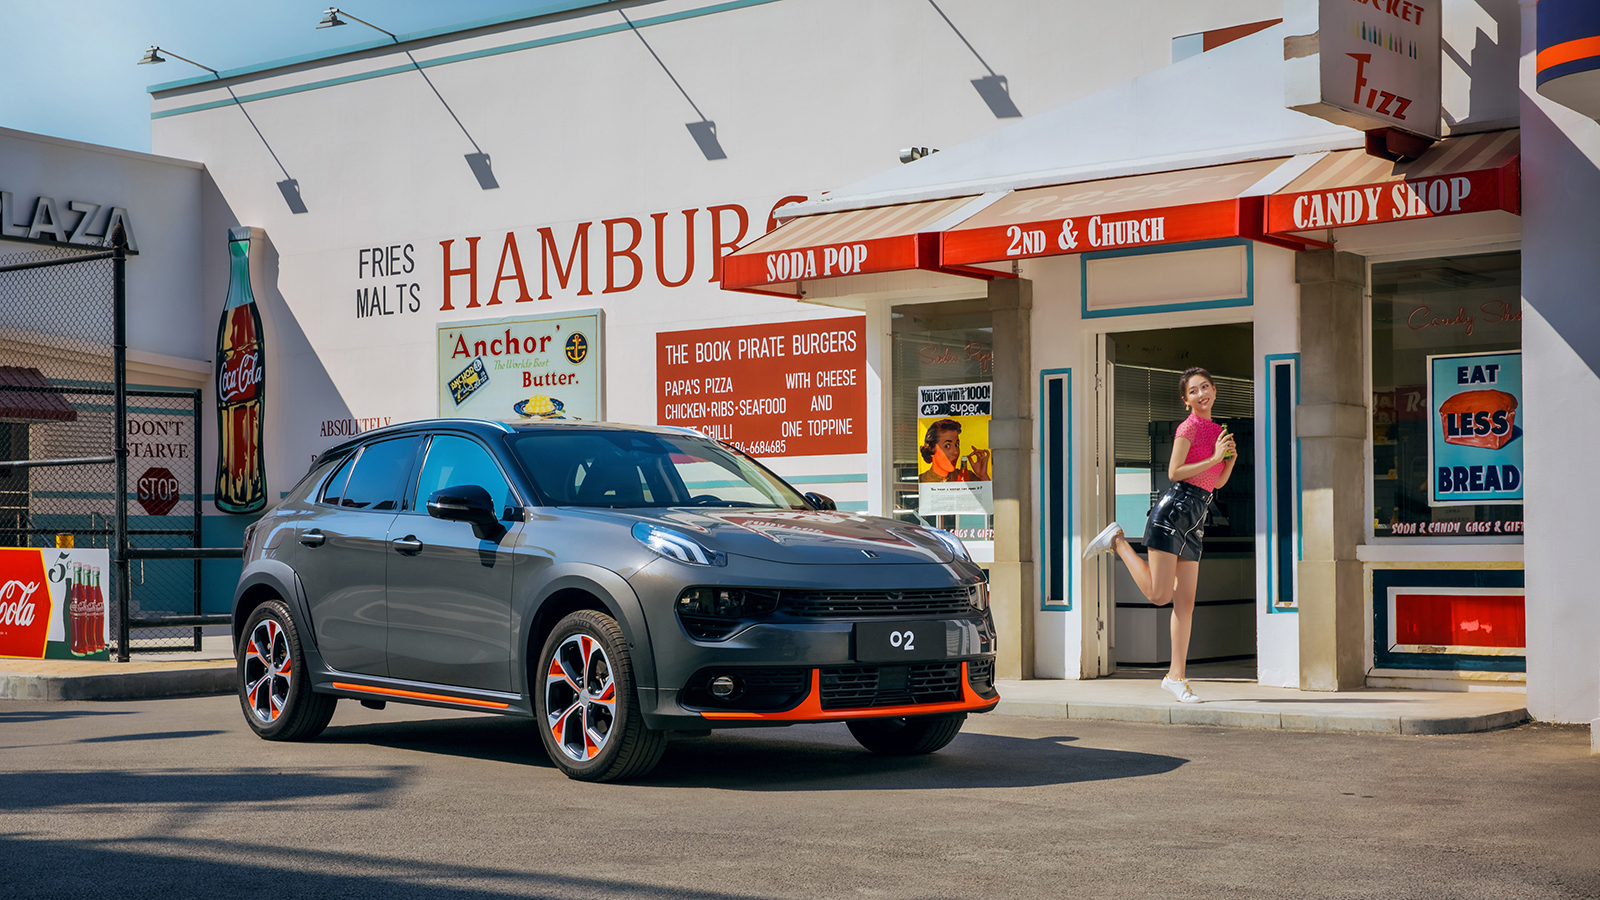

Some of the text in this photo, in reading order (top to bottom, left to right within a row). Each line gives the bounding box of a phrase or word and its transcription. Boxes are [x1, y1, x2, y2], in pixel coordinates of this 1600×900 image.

[1345, 52, 1412, 120] FIZZ
[1293, 177, 1471, 229] CANDY SHOP
[0, 191, 138, 253] LAZA
[1006, 215, 1165, 257] 2ND & CHURCH
[358, 244, 415, 279] FRIES
[439, 195, 808, 311] HAMBUR
[766, 244, 868, 282] SODA POP
[356, 283, 421, 318] MALTS
[1407, 306, 1474, 336] Candy
[665, 330, 857, 365] THE BOOK PIRATE BURGERS
[522, 371, 579, 388] Butter.
[665, 377, 733, 396] PAPA'S PIZZA
[785, 369, 857, 389] WITH CHEESE
[1457, 364, 1500, 386] EAT
[811, 395, 833, 412] AND
[128, 420, 184, 435] DON'T
[702, 424, 733, 440] CHILLI
[781, 421, 802, 438] ONE
[1447, 410, 1510, 438] LESS
[139, 478, 178, 500] STOP
[1438, 465, 1522, 493] BREAD
[1391, 522, 1416, 534] SODA
[1419, 521, 1426, 534] &
[1428, 522, 1461, 534] CANDY
[1465, 521, 1491, 533] GAGS
[1494, 520, 1502, 533] &
